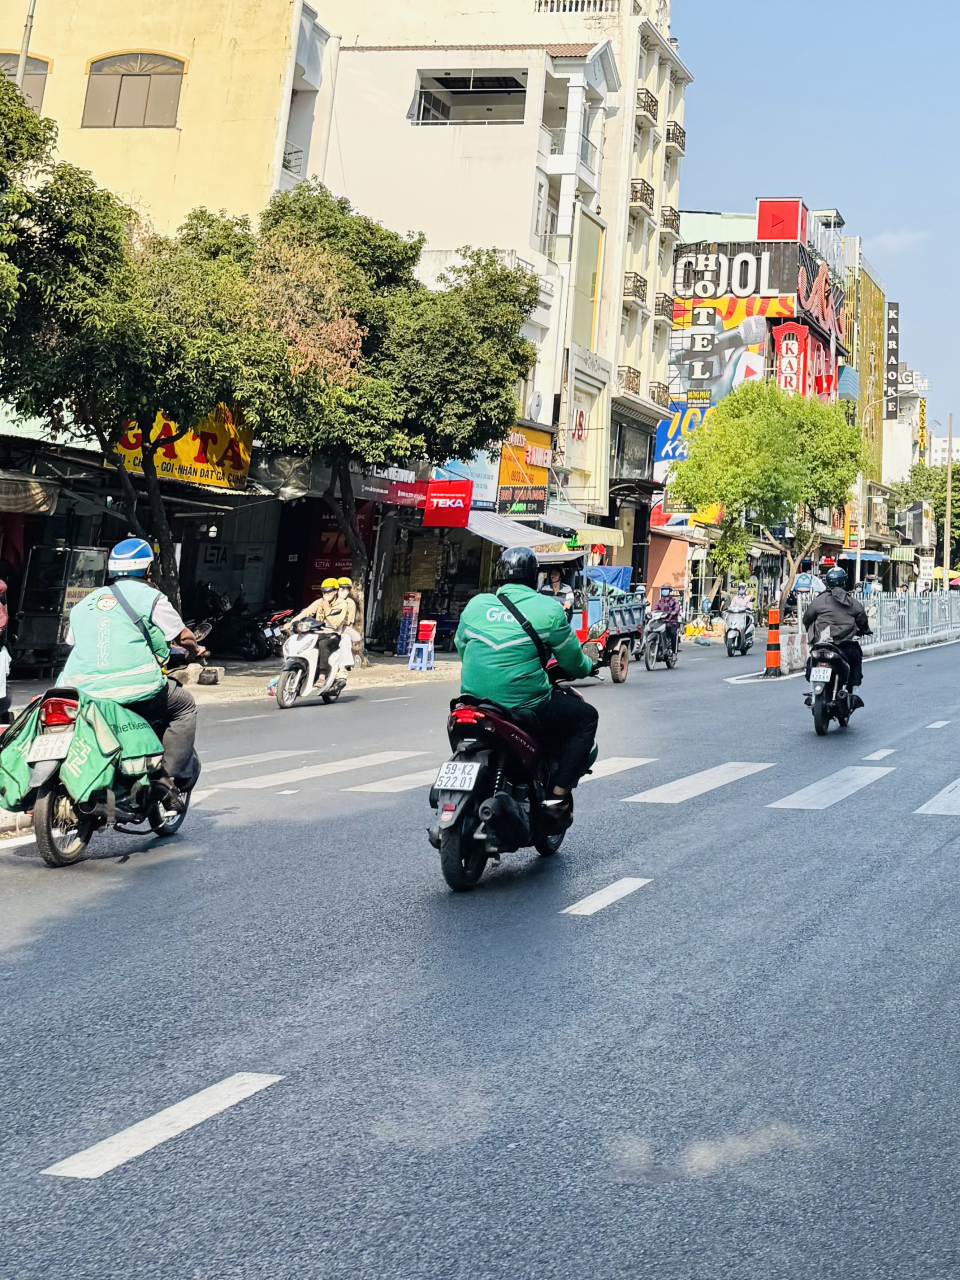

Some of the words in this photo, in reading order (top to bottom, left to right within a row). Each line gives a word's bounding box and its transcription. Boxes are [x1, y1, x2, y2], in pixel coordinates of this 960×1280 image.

[691, 254, 718, 380] HOTEL
[887, 310, 898, 411] KARAOKE
[431, 499, 464, 508] TEKA
[98, 618, 111, 668] GHTK
[38, 734, 66, 747] 55-P4
[444, 763, 475, 776] 59-K2
[436, 776, 473, 789] 522.01
